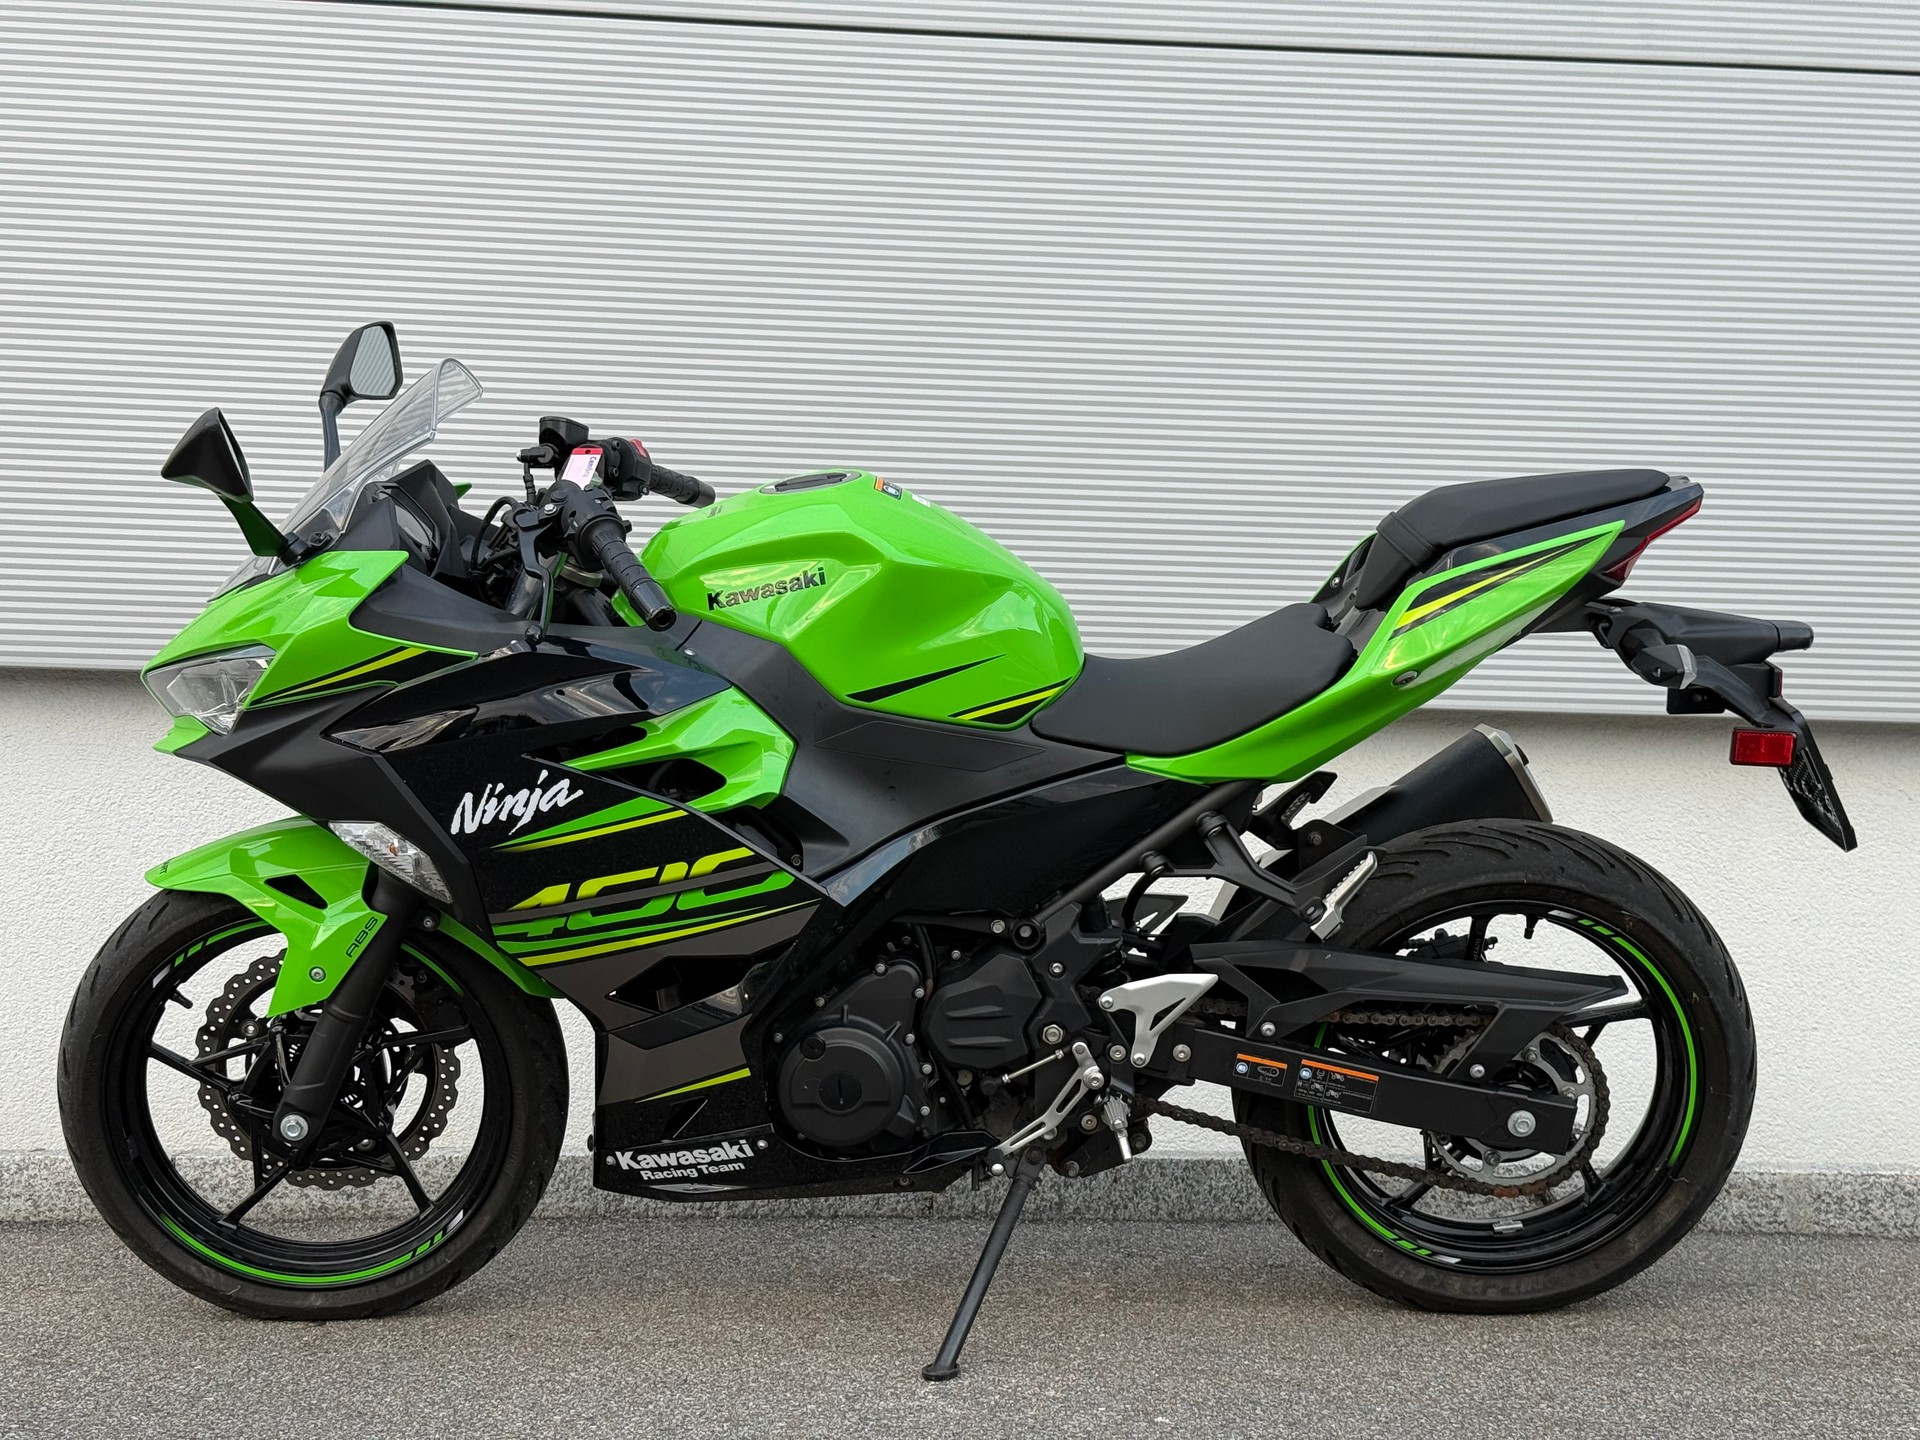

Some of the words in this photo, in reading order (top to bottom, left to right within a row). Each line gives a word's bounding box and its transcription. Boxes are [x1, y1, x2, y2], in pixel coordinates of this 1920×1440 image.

[707, 566, 827, 611] Kawasaki
[450, 769, 584, 836] Ninja
[492, 847, 795, 938] 400
[345, 916, 378, 958] ABS
[615, 1139, 755, 1170] Kawasaki
[639, 1167, 699, 1181] Racing
[697, 1162, 746, 1175] Team
